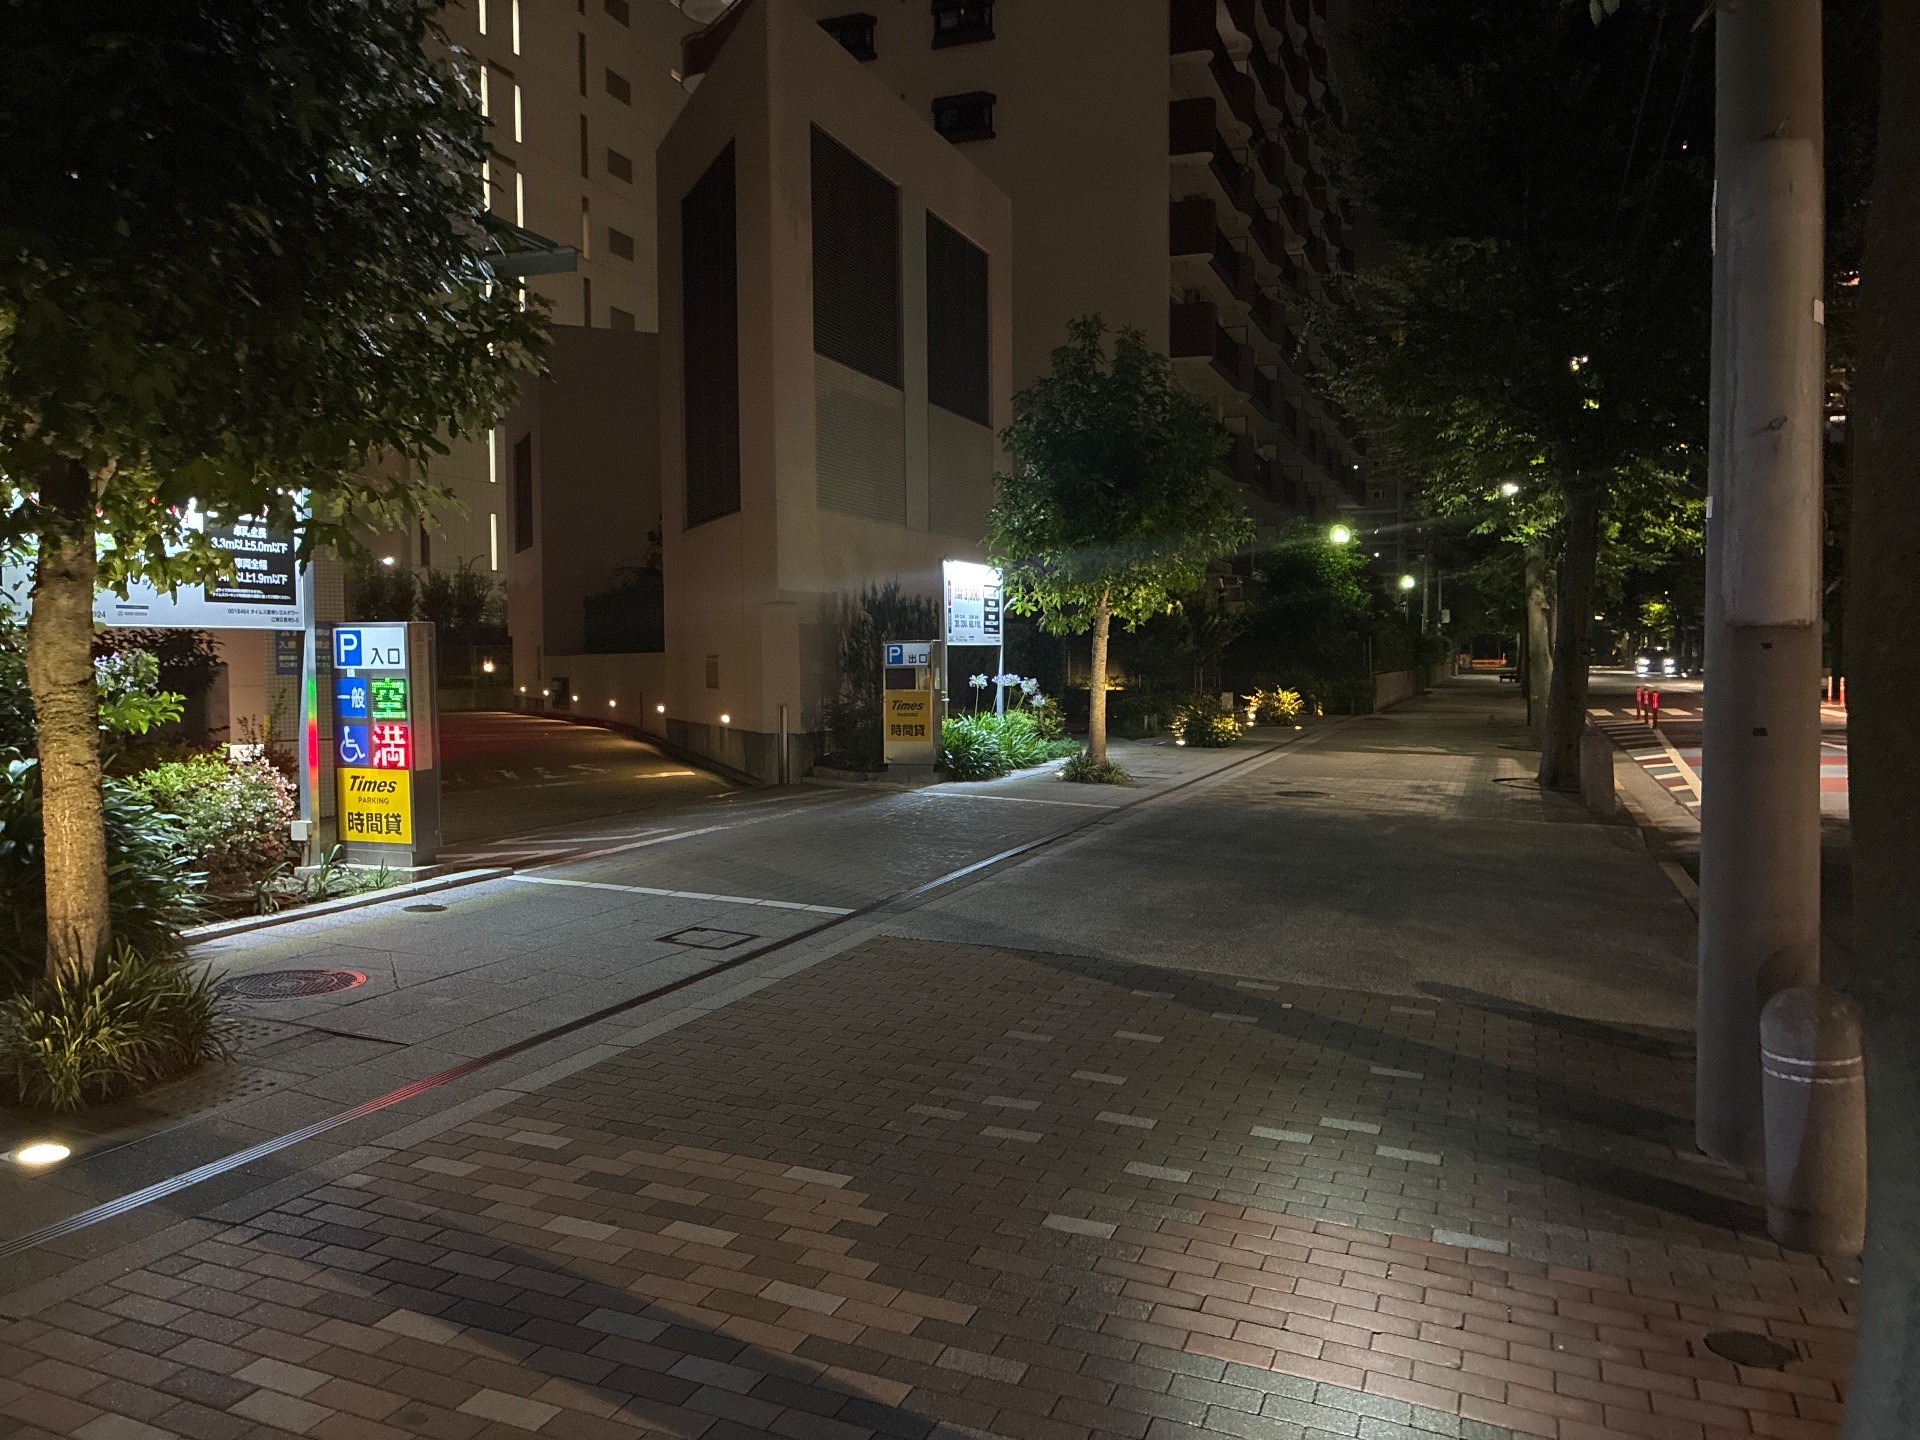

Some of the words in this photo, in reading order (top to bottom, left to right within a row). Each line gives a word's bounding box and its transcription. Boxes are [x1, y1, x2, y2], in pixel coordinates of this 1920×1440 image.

[211, 537, 288, 553] 3.3m以上5.0m以下
[340, 633, 358, 663] P
[371, 648, 400, 664] 入口
[889, 646, 901, 663] P
[908, 653, 928, 664] 出口
[337, 686, 366, 709] 一般
[371, 677, 406, 718] 空
[891, 700, 925, 711] Times
[891, 724, 926, 737] 時間貸
[372, 725, 406, 767] 満
[349, 775, 397, 793] Times
[358, 796, 389, 805] PARKING
[347, 811, 402, 836] 時間貸
